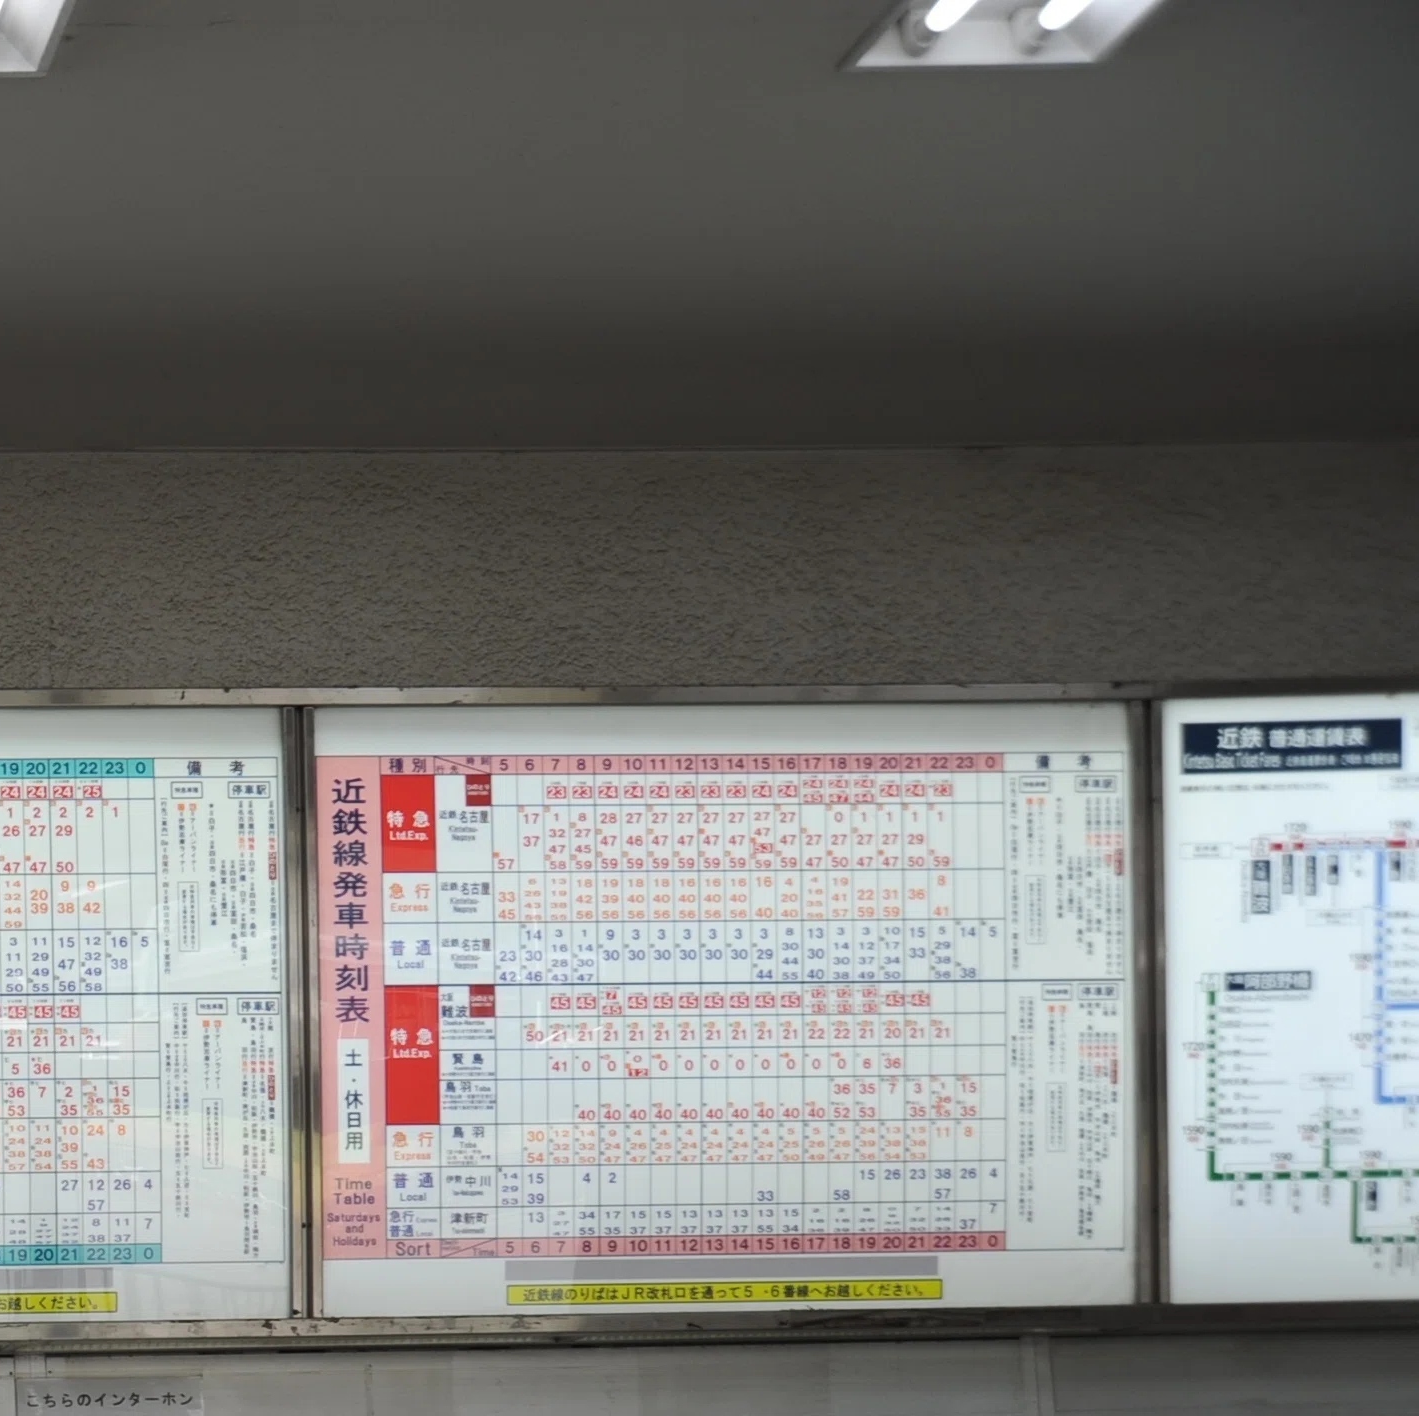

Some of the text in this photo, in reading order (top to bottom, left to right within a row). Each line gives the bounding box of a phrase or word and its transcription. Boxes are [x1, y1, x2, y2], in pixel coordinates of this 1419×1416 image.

[331, 778, 370, 1024] 近鉄線発車時刻表
[327, 1212, 381, 1225] Saturdays
[345, 1224, 364, 1234] and
[332, 1236, 377, 1249] Holidays
[395, 1241, 431, 1257] Sort
[26, 1393, 194, 1409] こちらのインターホン
